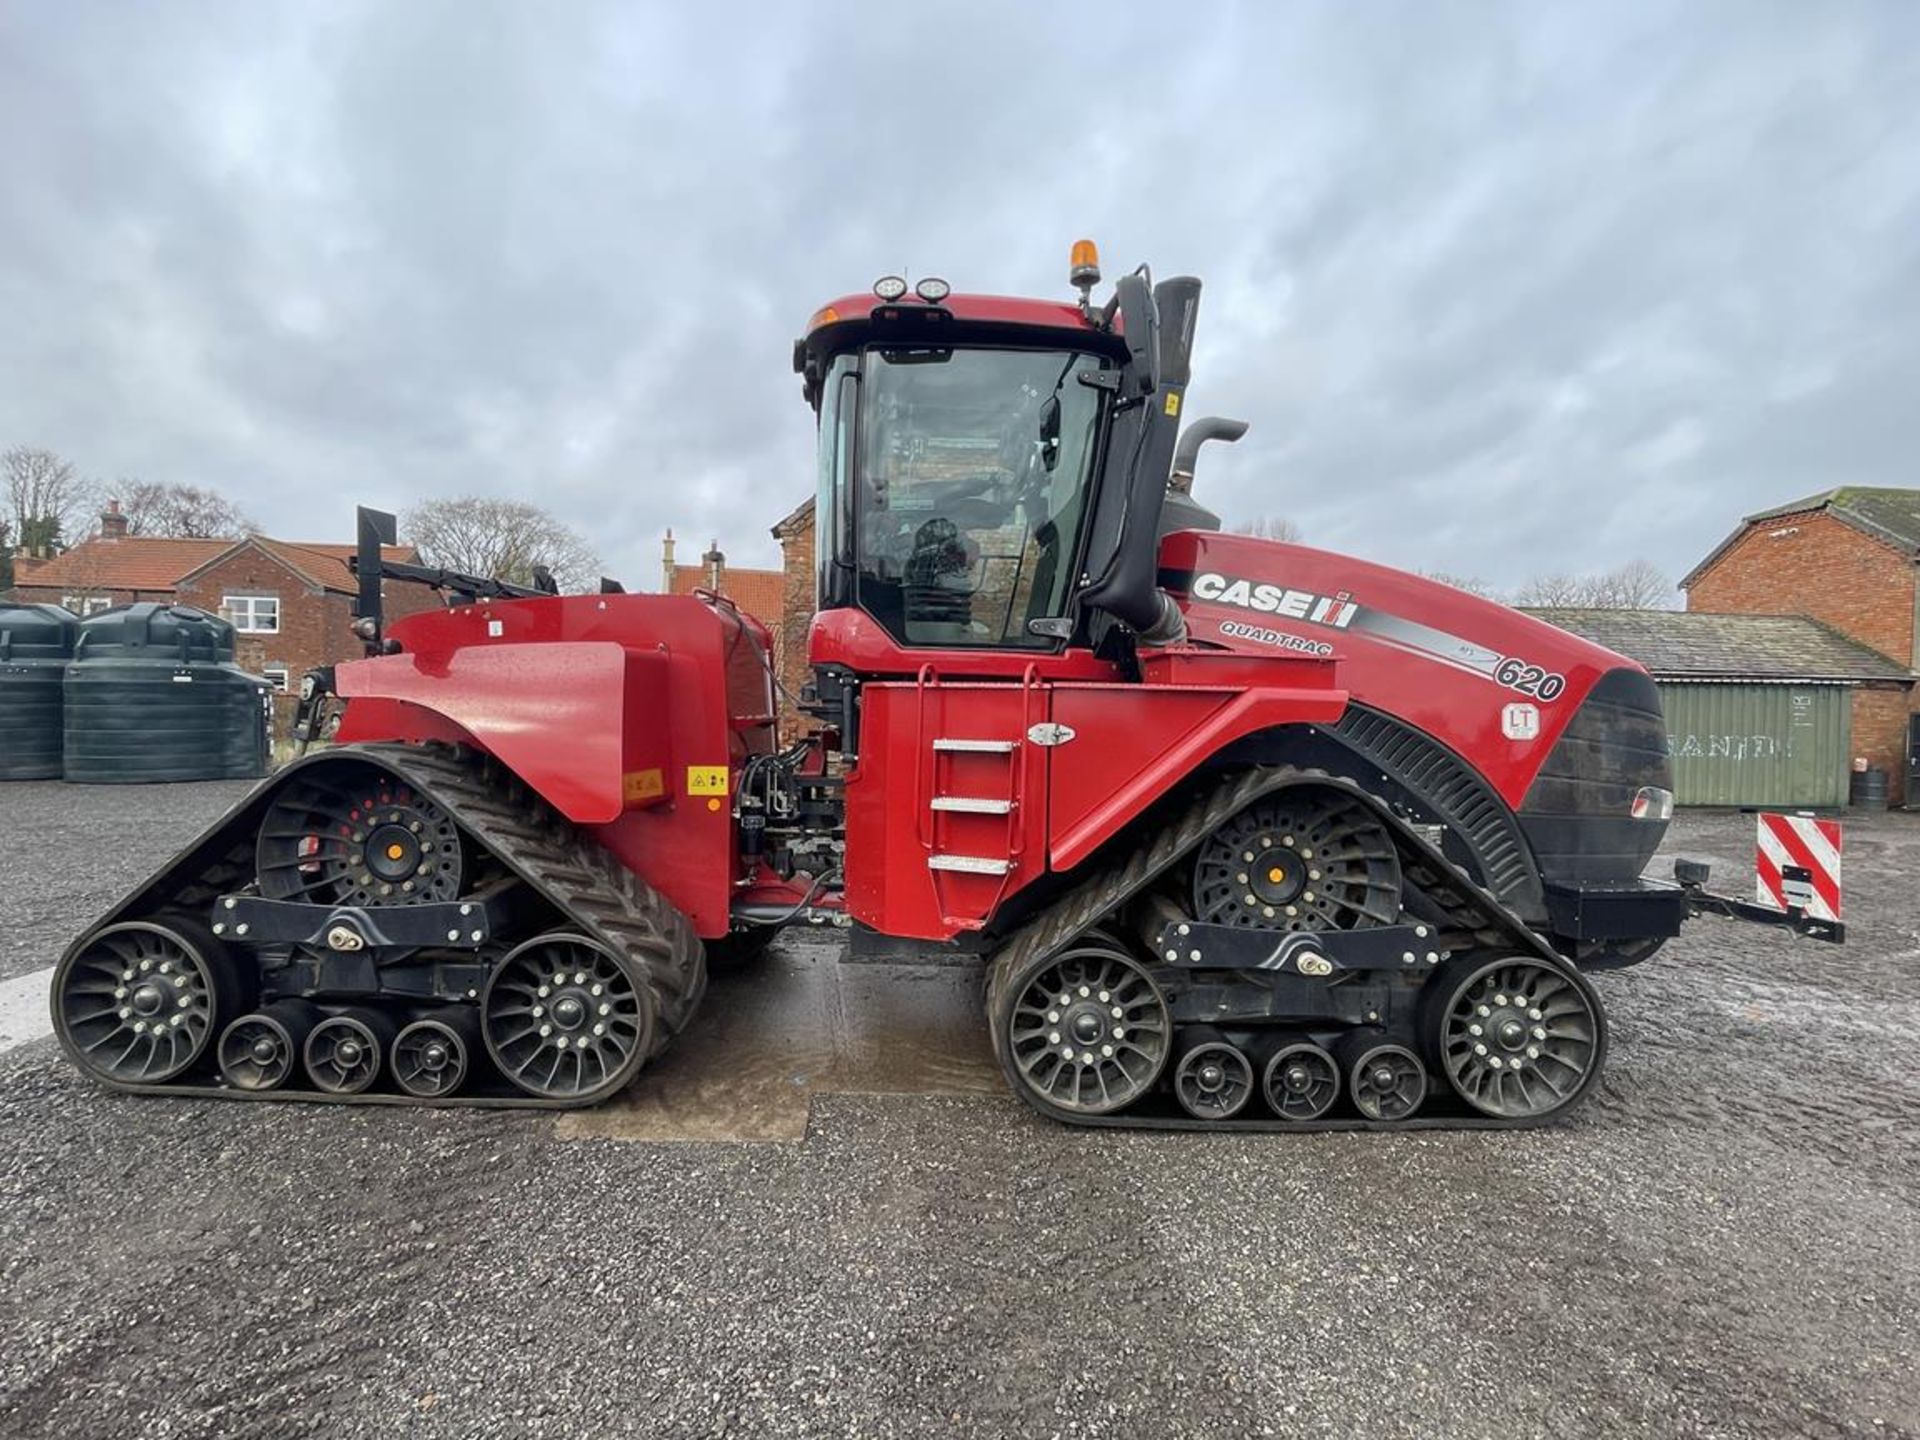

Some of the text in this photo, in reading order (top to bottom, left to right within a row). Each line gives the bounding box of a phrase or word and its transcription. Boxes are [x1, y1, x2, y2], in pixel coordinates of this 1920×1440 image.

[1193, 573, 1315, 619] CASE
[1220, 621, 1333, 656] QUADTRAC
[1495, 658, 1565, 702] 620
[1509, 709, 1533, 727] LT
